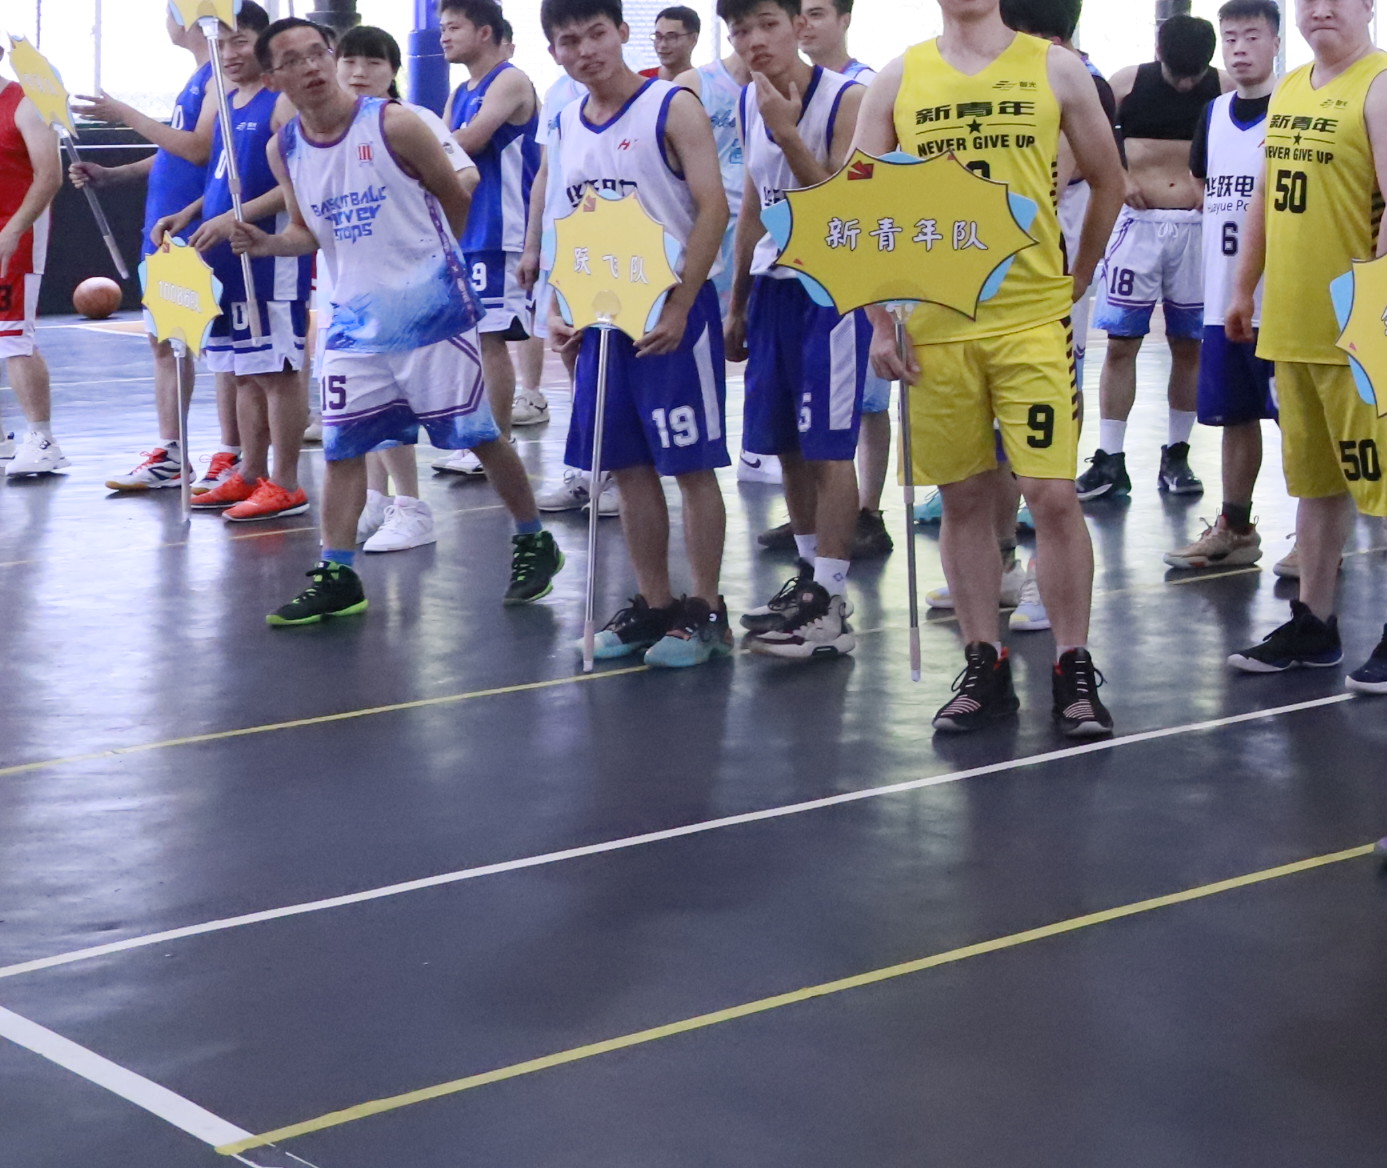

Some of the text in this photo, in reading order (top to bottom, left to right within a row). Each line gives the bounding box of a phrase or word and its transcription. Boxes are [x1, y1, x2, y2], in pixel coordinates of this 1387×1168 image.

[917, 134, 1036, 157] NEVER GIVE UP
[1293, 148, 1313, 162] GIVE
[1317, 151, 1334, 165] UP
[1274, 169, 1308, 214] 50
[824, 216, 990, 252] 新青年队
[1222, 221, 1239, 256] 6
[573, 246, 649, 285] 跃飞队
[1108, 265, 1135, 297] 18
[652, 403, 700, 448] 19
[1026, 403, 1055, 448] 9
[1340, 438, 1380, 482] 50
